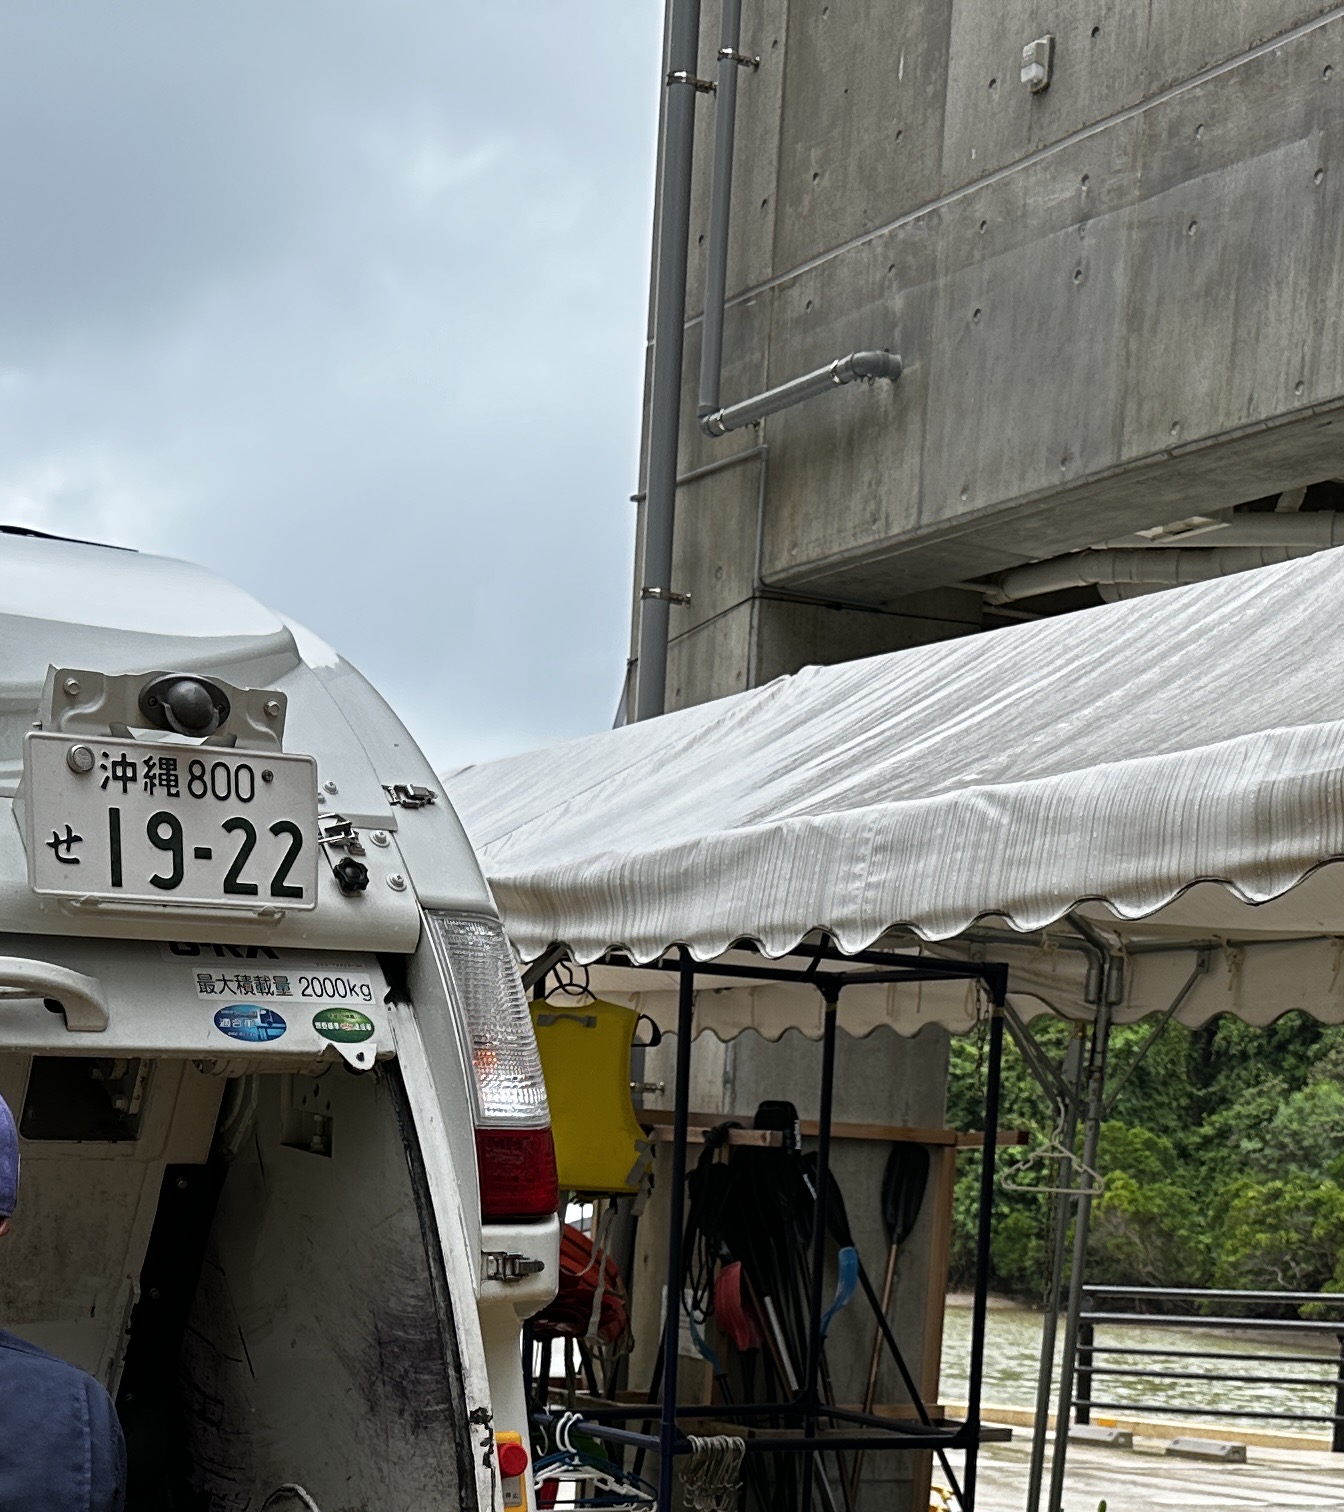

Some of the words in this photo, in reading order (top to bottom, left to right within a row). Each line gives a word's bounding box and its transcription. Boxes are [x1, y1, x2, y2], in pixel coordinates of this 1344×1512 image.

[45, 824, 83, 865] せ
[108, 807, 304, 899] 19-22
[196, 973, 294, 997] 最大積載量
[298, 976, 373, 1002] 2000kg
